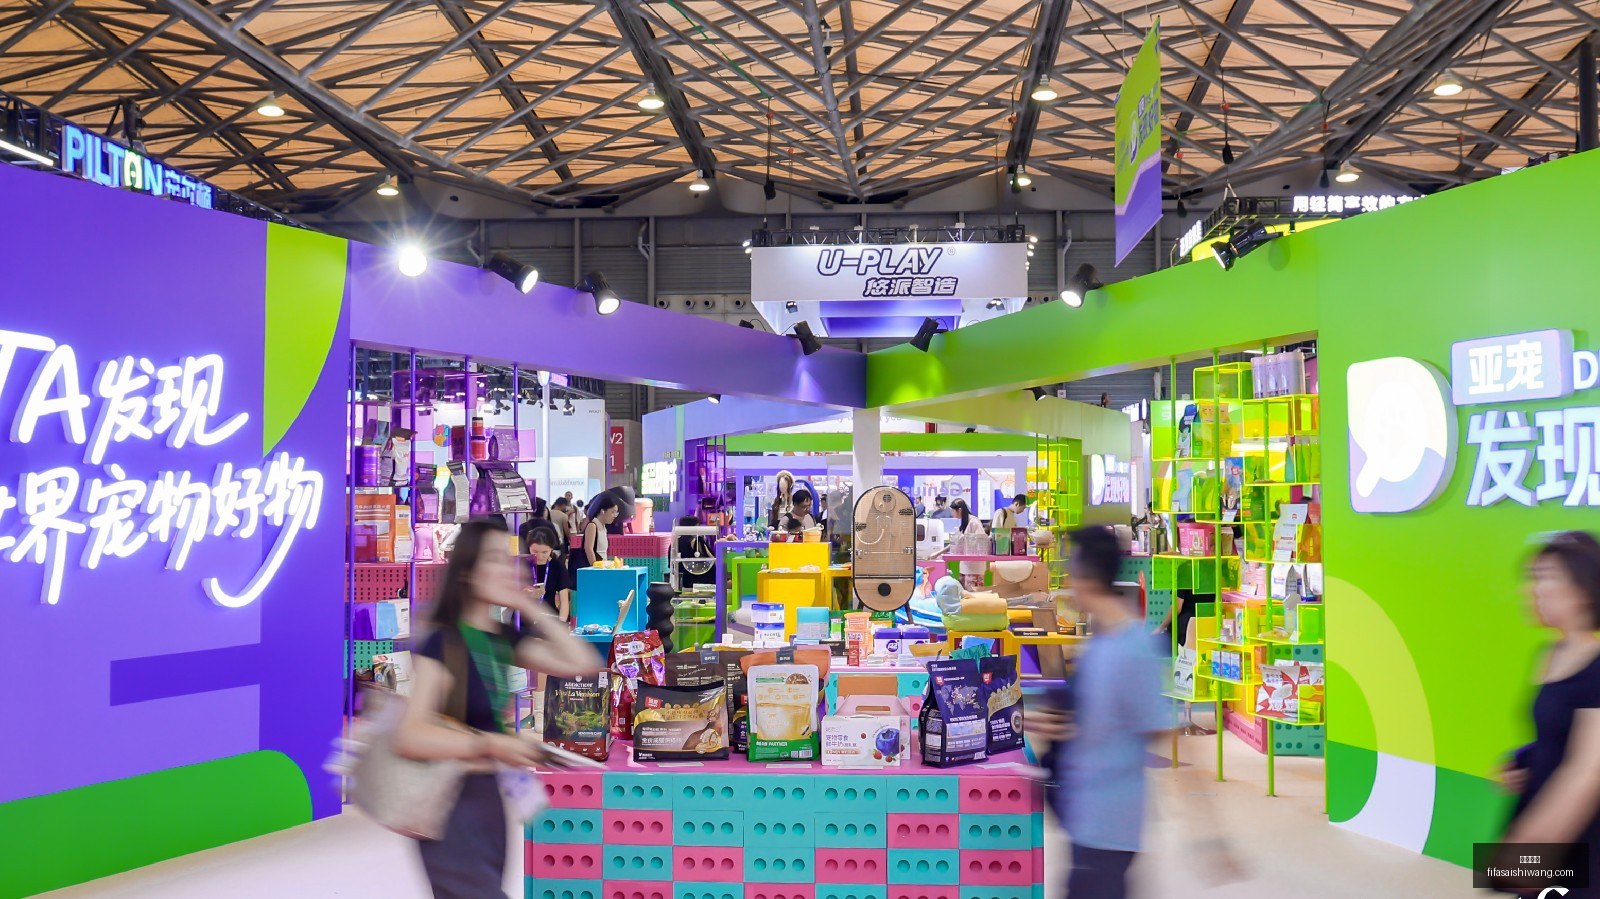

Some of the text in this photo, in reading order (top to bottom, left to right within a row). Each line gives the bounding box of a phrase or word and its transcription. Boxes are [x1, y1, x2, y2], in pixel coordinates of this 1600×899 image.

[817, 247, 943, 276] U-PLAY
[863, 276, 958, 298] 悠派智造
[1468, 339, 1544, 395] 亚宠
